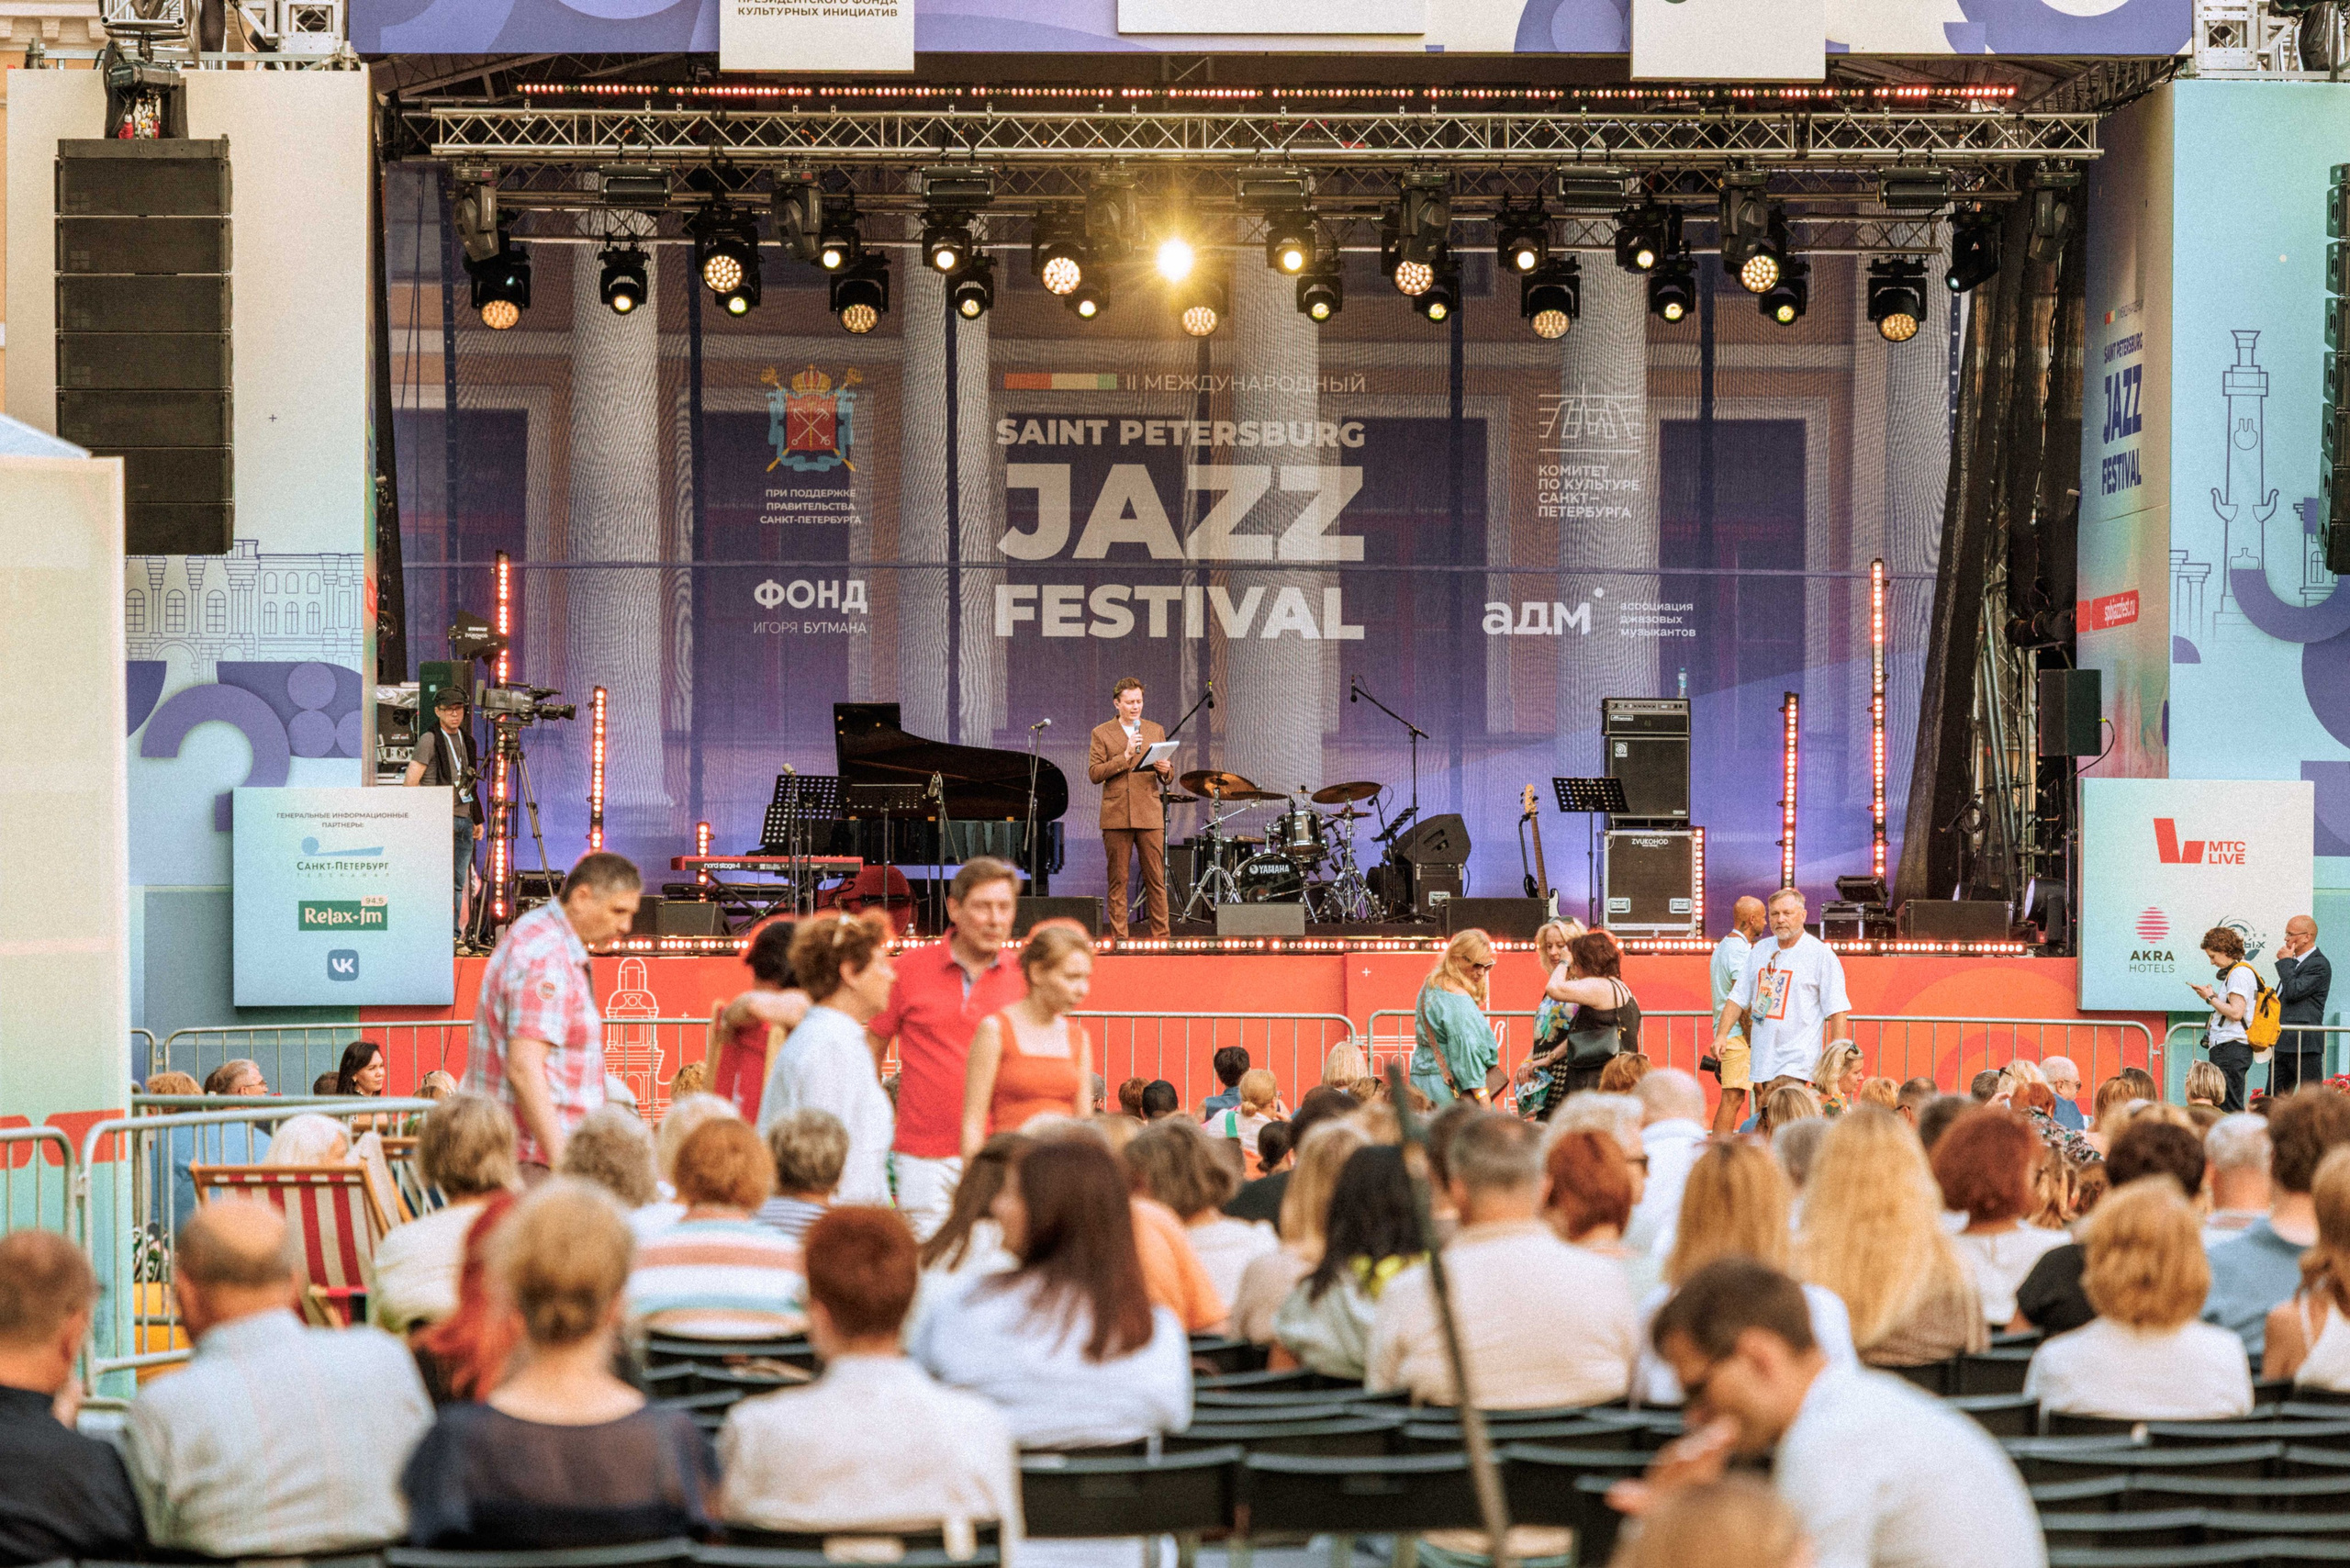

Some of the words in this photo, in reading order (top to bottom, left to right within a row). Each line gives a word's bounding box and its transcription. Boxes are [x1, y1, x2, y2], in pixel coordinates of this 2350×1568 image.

[737, 7, 819, 16] КУЛЬТУРНЫХ
[822, 7, 898, 17] ИНИЦИАТИВ
[2104, 341, 2116, 364] SAINT
[2116, 330, 2143, 359] PETERSBURG
[1125, 375, 1136, 390] II
[1144, 373, 1366, 394] МЕЖДУНАРОДНЫЙ
[2103, 364, 2143, 444] JAZZ
[995, 419, 1108, 445] SAINT
[1119, 420, 1366, 448] PETERSBURG
[1539, 465, 1610, 477] КОМИТЕТ
[2101, 448, 2143, 497] FESTIVAL
[1539, 478, 1561, 491] ПО
[1564, 478, 1640, 492] КУЛЬТУРЕ
[765, 488, 788, 498] ПРИ
[789, 488, 856, 498] ПОДДЕРЖКЕ
[766, 502, 856, 511] ПРАВИТЕЛЬСТВА
[996, 463, 1366, 562] JAZZ
[1539, 506, 1632, 519] ПЕТЕРБУРГА
[759, 515, 862, 524] САНКТ-ПЕТЕРБУРГА
[754, 579, 868, 614] ФОНД
[994, 583, 1366, 640] FESTIVAL
[1619, 601, 1694, 613] ассоциация
[1619, 614, 1684, 626] джазовых
[753, 622, 799, 634] ИГОРЯ
[802, 622, 867, 634] БУТМАНА
[1619, 626, 1697, 638] музыкантов
[331, 812, 409, 820] ИНФОРМАЦИОННЫЕ
[1631, 837, 1669, 846] ZVUKOHOD
[2209, 853, 2246, 865] LIVE
[1259, 864, 1290, 874] YAMAHA
[2130, 950, 2176, 961] AKRA
[2129, 963, 2176, 973] HOTELS
